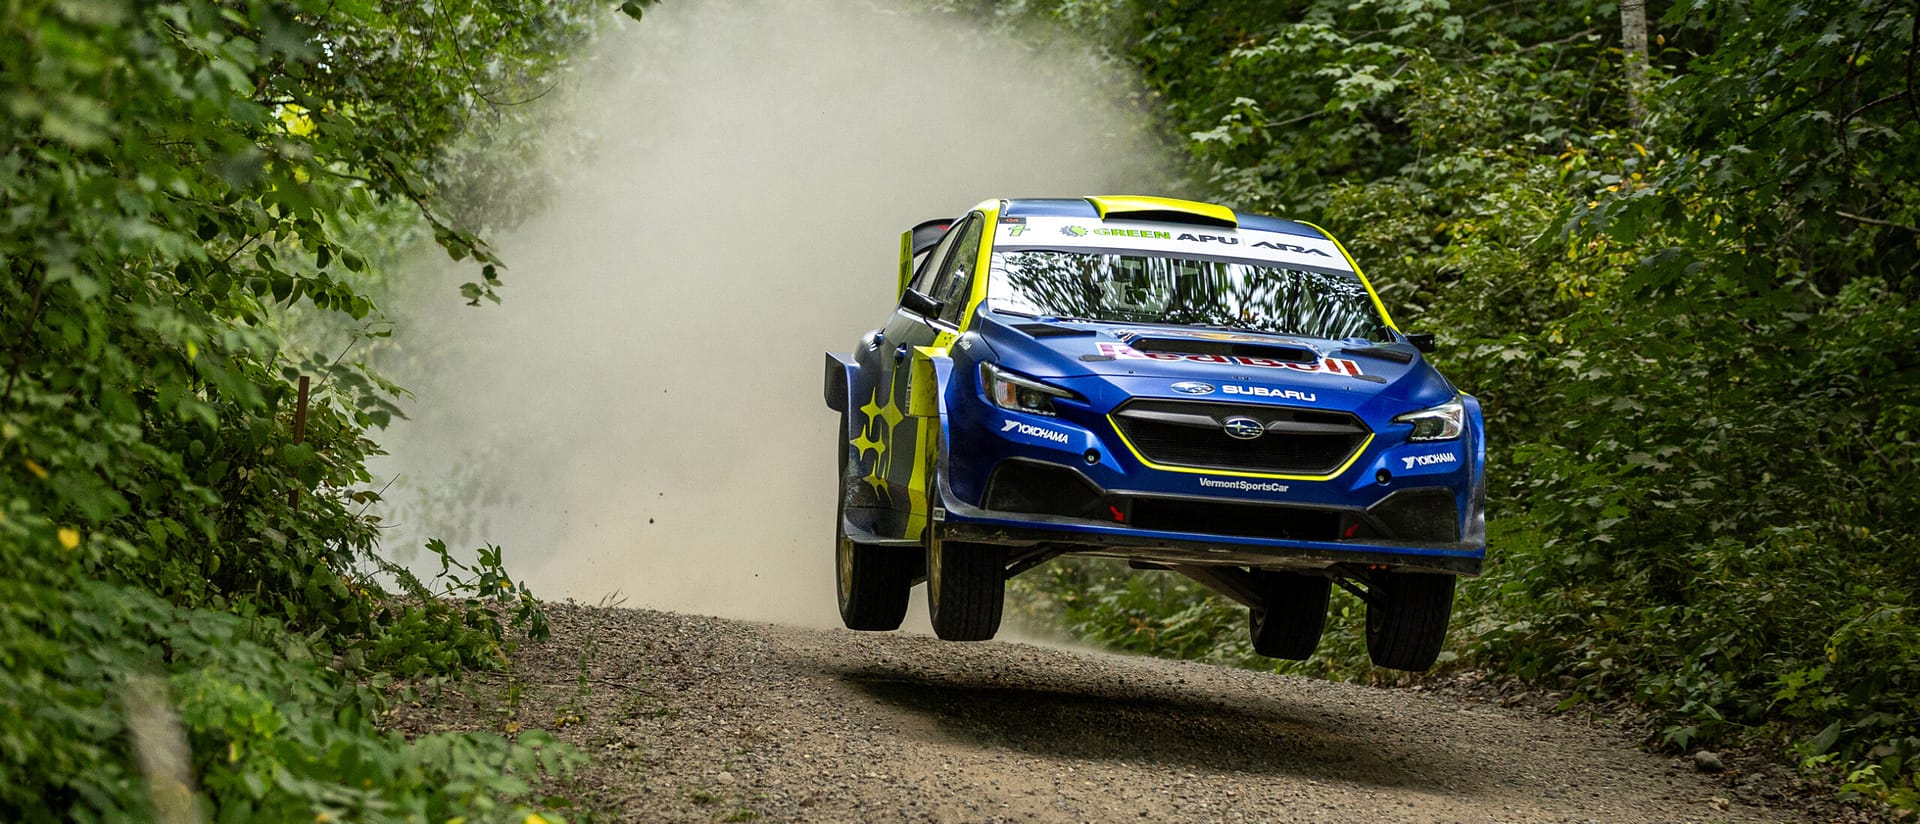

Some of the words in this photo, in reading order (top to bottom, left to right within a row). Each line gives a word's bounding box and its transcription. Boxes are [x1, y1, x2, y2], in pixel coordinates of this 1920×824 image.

[1093, 228, 1171, 240] GREEN
[1177, 233, 1239, 245] APU
[1251, 241, 1333, 258] ARA
[1222, 384, 1316, 402] SUBARU
[1017, 423, 1069, 444] YOKOHAMA
[1416, 452, 1457, 466] YOKOHAMA
[1199, 477, 1289, 492] VermontSportsCar
